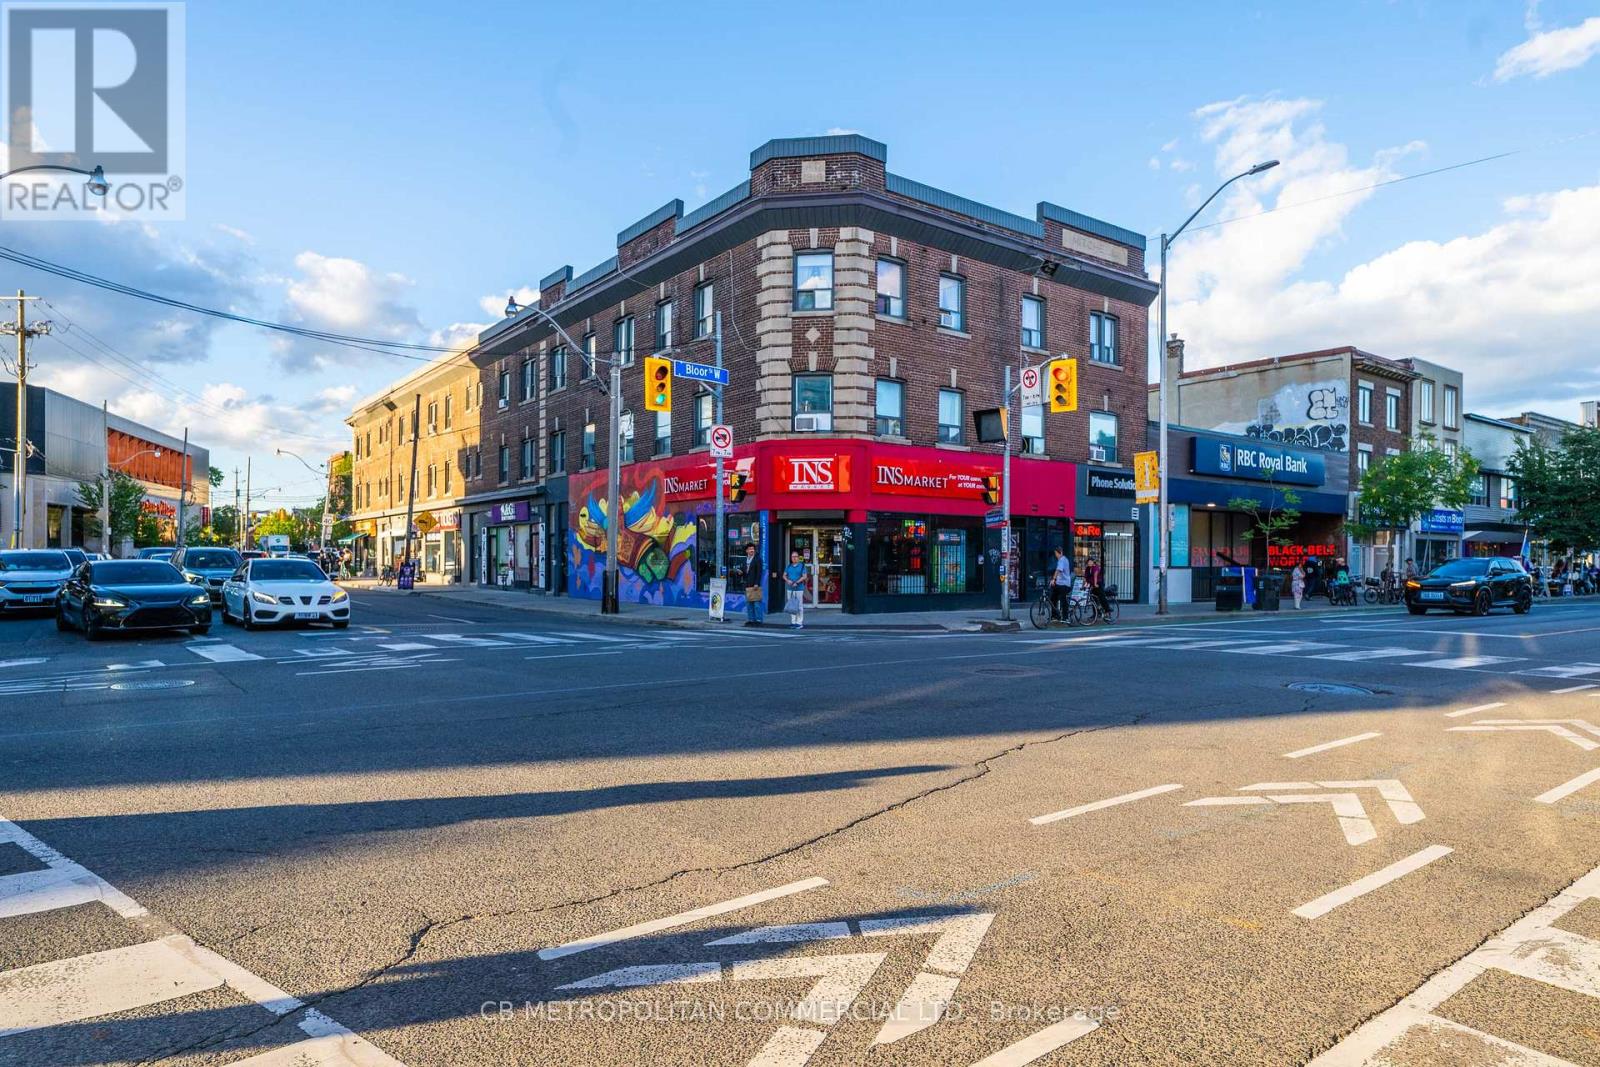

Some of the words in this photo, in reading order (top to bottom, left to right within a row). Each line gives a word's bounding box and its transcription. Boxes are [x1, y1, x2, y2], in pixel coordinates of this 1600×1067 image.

[685, 364, 708, 377] Bloor
[713, 368, 721, 379] W
[1237, 449, 1257, 468] RBC
[1259, 451, 1284, 473] Royal
[1285, 455, 1308, 474] Bank
[791, 461, 834, 484] INS
[877, 465, 904, 486] INS
[903, 475, 949, 489] MARKET
[678, 479, 708, 493] MARKET
[1091, 476, 1114, 489] Phone
[1114, 478, 1137, 490] Solutio
